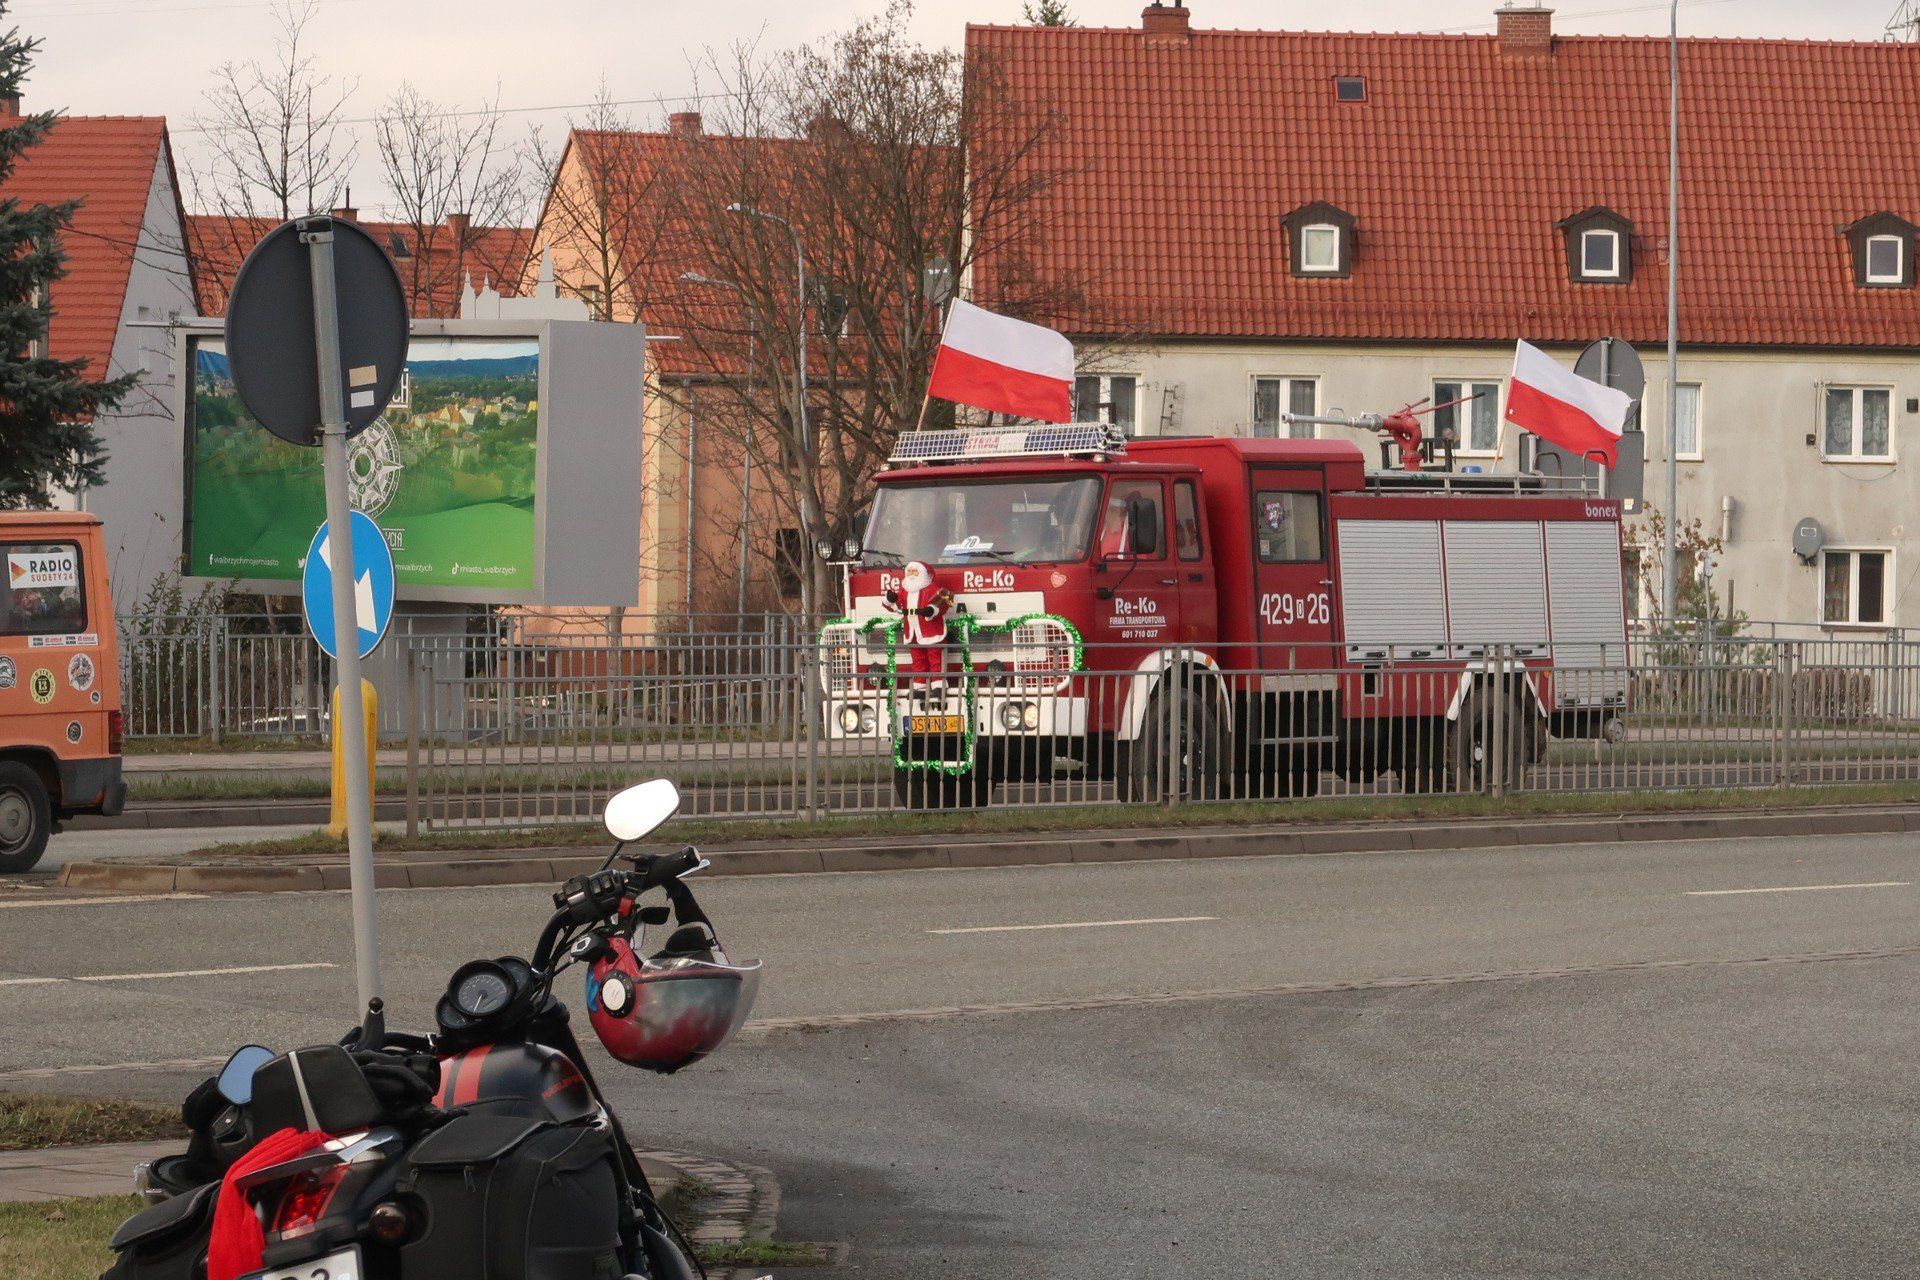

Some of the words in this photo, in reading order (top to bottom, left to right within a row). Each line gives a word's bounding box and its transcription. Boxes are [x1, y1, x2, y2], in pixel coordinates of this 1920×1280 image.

[1585, 501, 1617, 517] bonex
[29, 558, 72, 573] RADIO
[963, 570, 1015, 588] Re-Ko
[1115, 597, 1157, 614] Re-Ko
[1260, 593, 1294, 625] 429
[1306, 592, 1330, 625] 26
[1109, 616, 1126, 625] FIRMA
[1126, 615, 1166, 625] TRANSPORTOWA
[1121, 630, 1133, 638] 601
